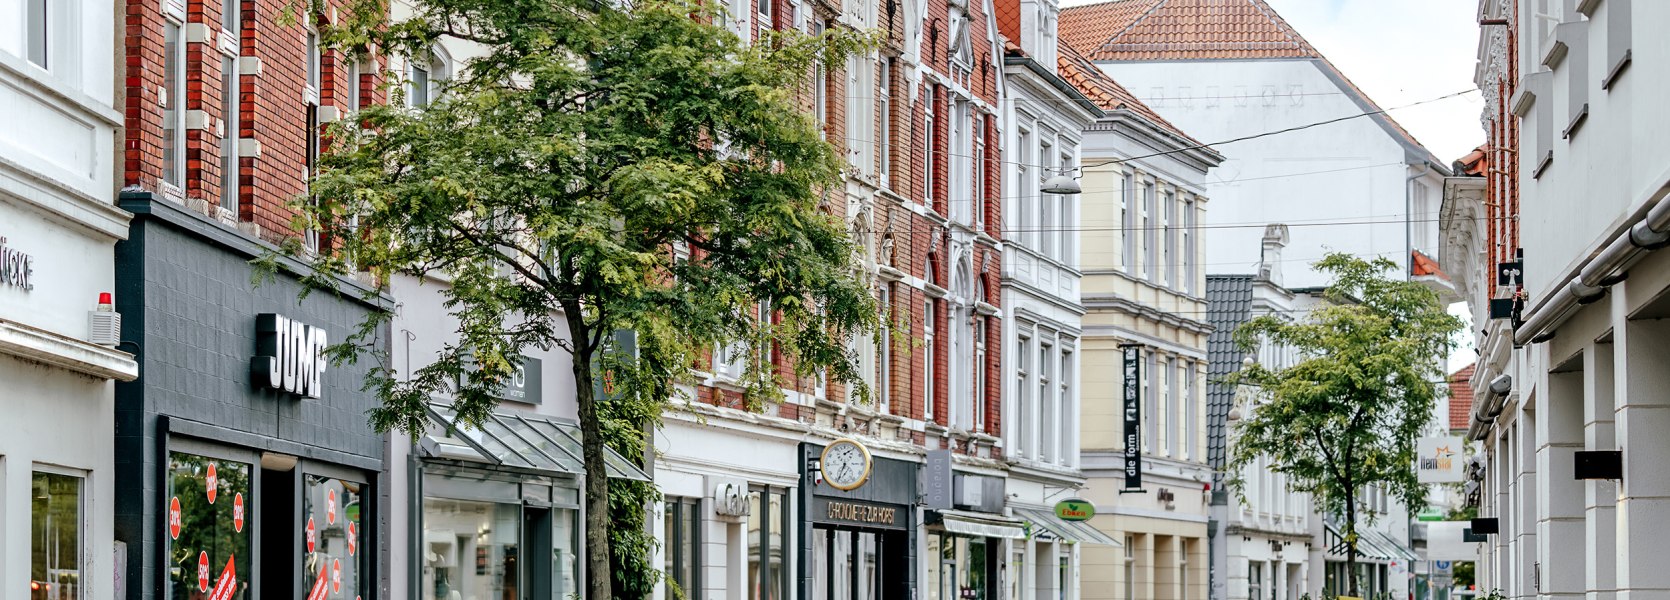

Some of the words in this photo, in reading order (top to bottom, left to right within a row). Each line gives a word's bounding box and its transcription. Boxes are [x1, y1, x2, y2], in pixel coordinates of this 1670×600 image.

[267, 313, 328, 399] JUMP
[1126, 434, 1136, 458] form
[1126, 460, 1136, 477] die
